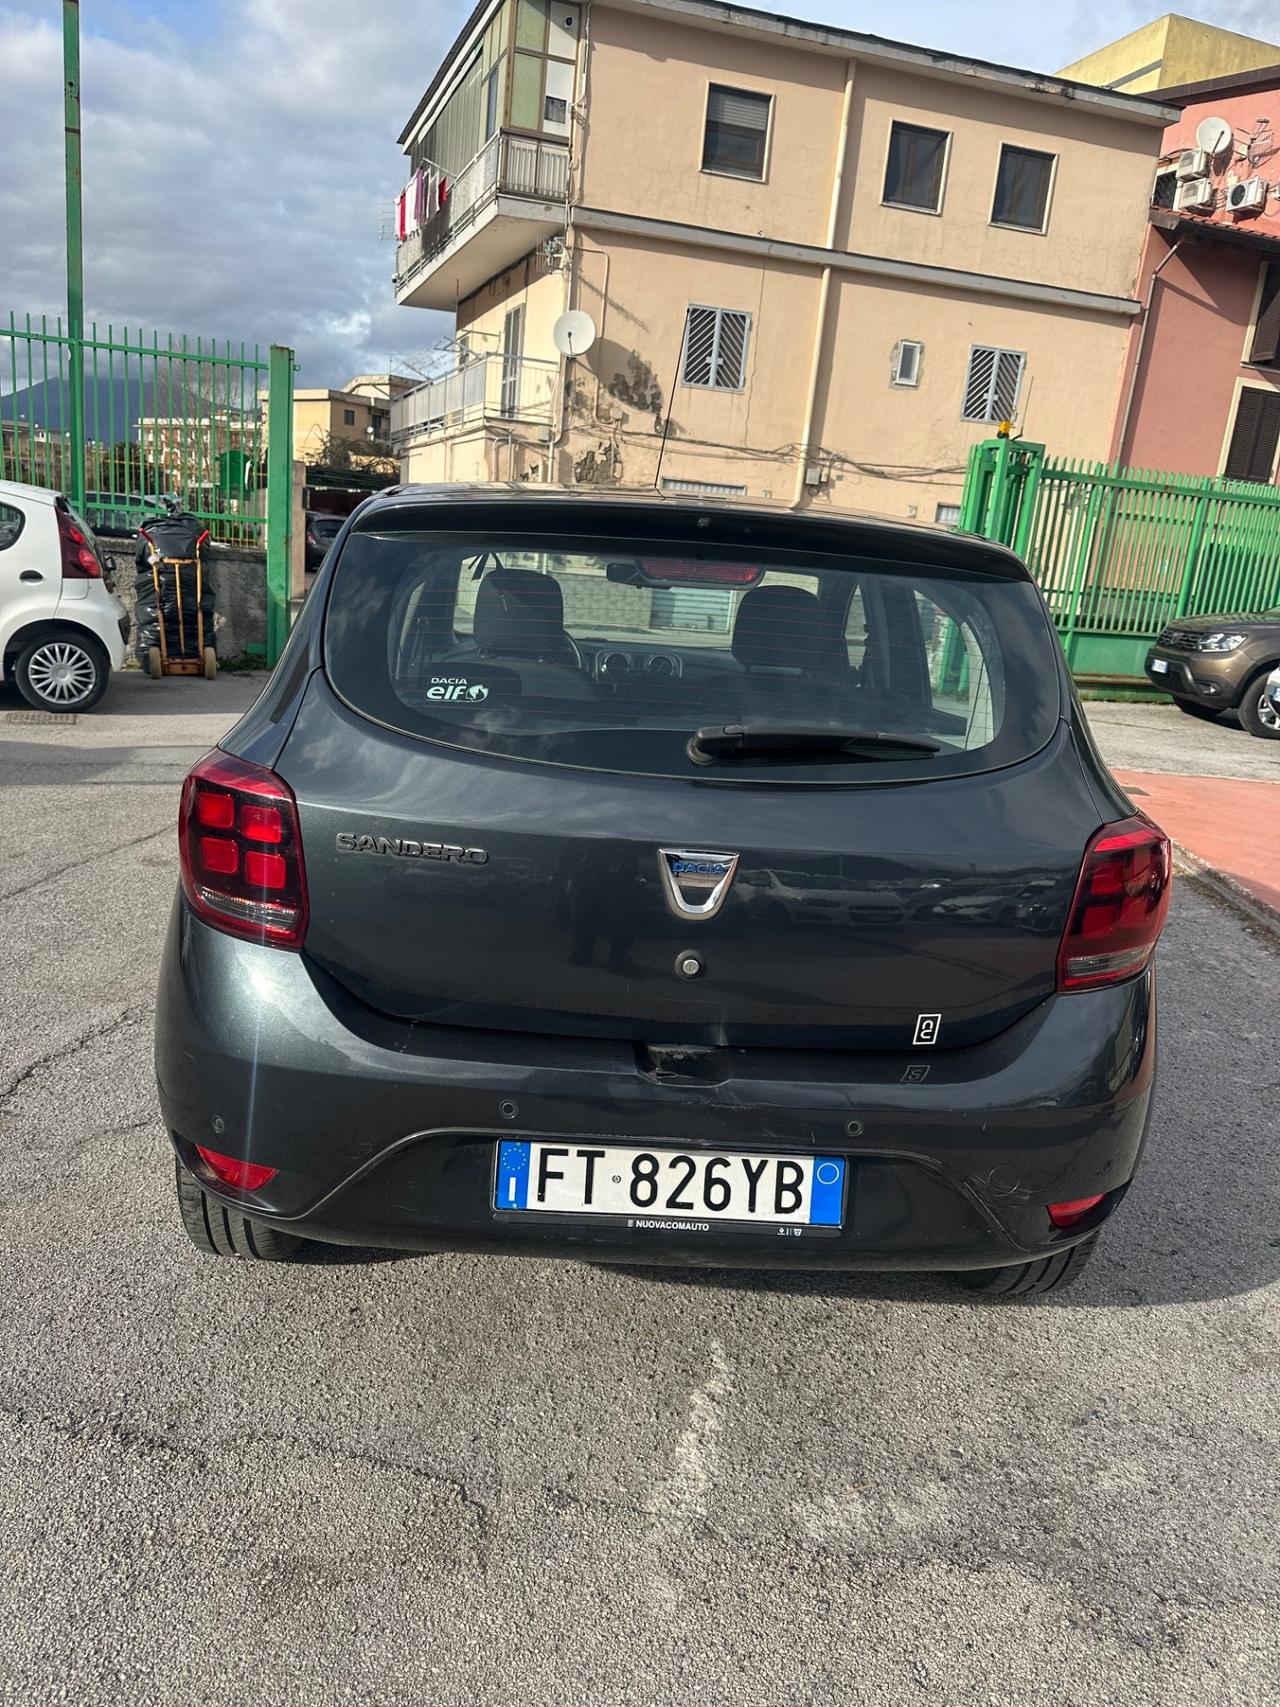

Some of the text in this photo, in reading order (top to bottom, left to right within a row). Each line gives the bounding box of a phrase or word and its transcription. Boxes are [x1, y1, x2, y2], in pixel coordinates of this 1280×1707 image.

[426, 686, 466, 700] elf
[336, 833, 489, 864] SANDERO
[672, 862, 725, 874] DACIA
[537, 1147, 606, 1205] FT
[629, 1153, 804, 1214] 826YB
[636, 1220, 710, 1232] NUOVACOMAUTO
